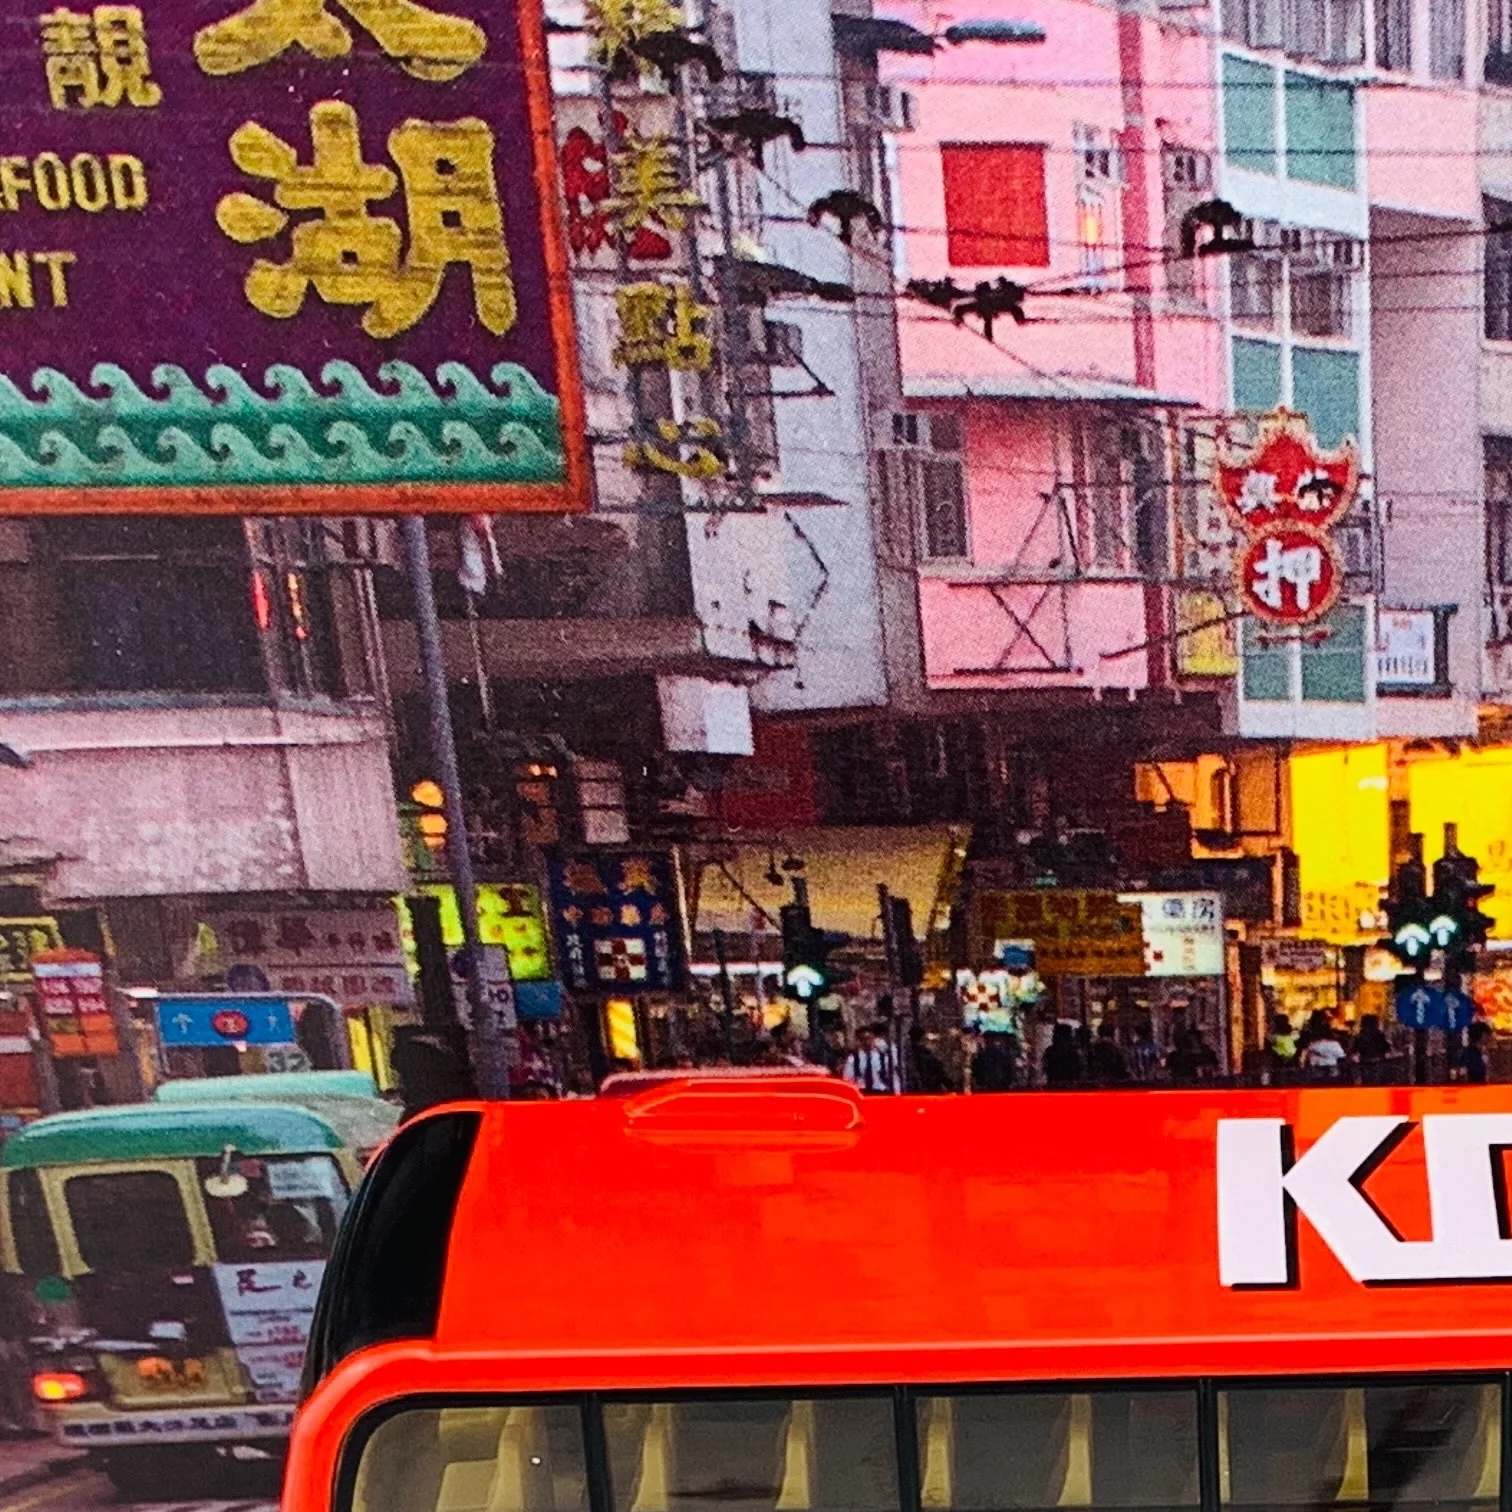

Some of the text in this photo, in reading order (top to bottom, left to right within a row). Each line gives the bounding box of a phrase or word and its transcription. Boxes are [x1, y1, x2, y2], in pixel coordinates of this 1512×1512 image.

[38, 4, 163, 110] 靚
[0, 152, 149, 212] FOOD
[1252, 538, 1322, 610] 押
